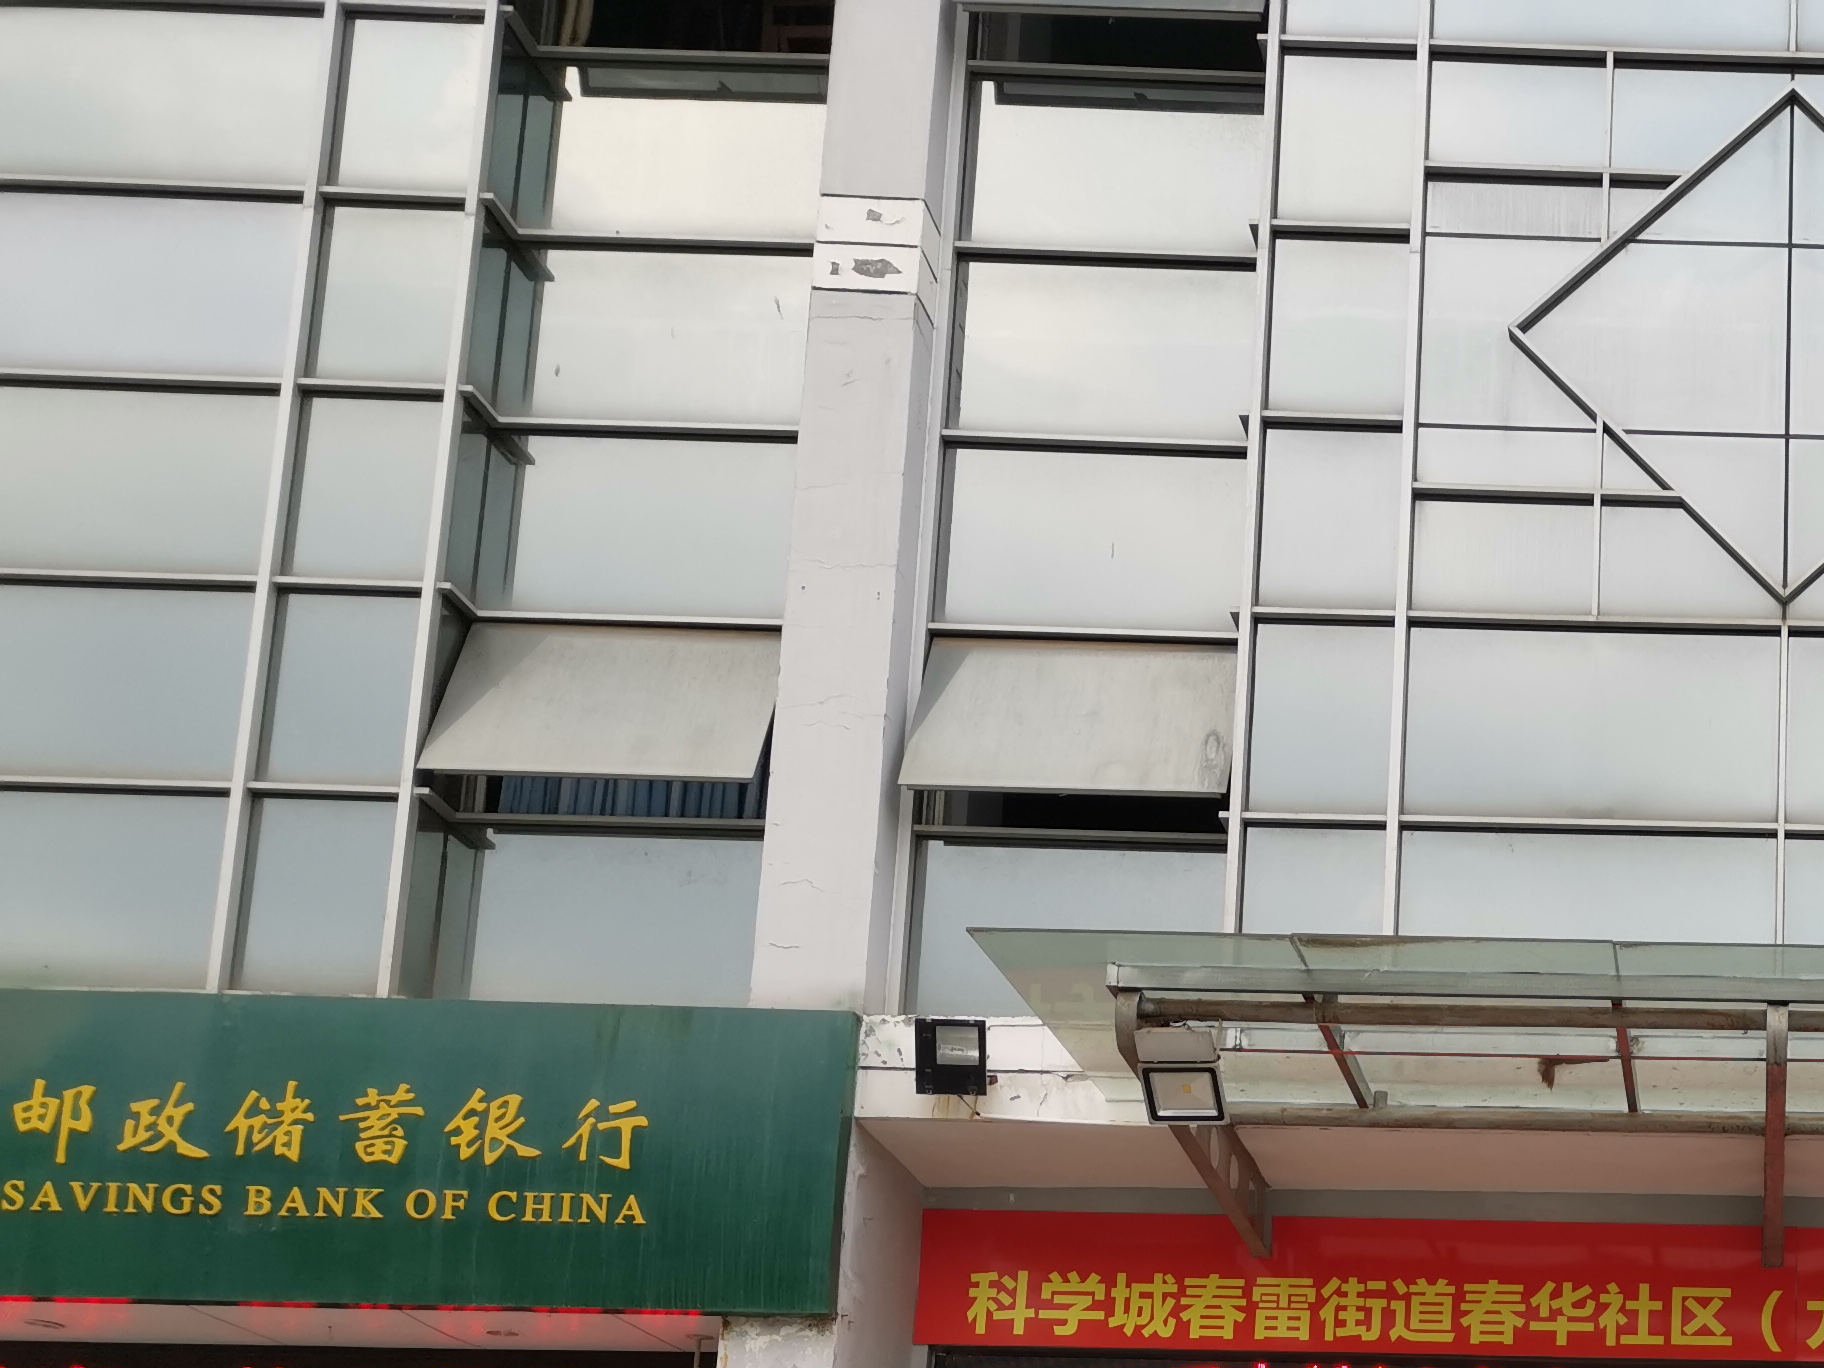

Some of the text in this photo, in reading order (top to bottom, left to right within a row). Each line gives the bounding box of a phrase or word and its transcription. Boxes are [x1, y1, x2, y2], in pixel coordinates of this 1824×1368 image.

[12, 1078, 649, 1170] 邮政储蓄银行
[2, 1179, 647, 1225] SAVINGS BANK OF CHINA
